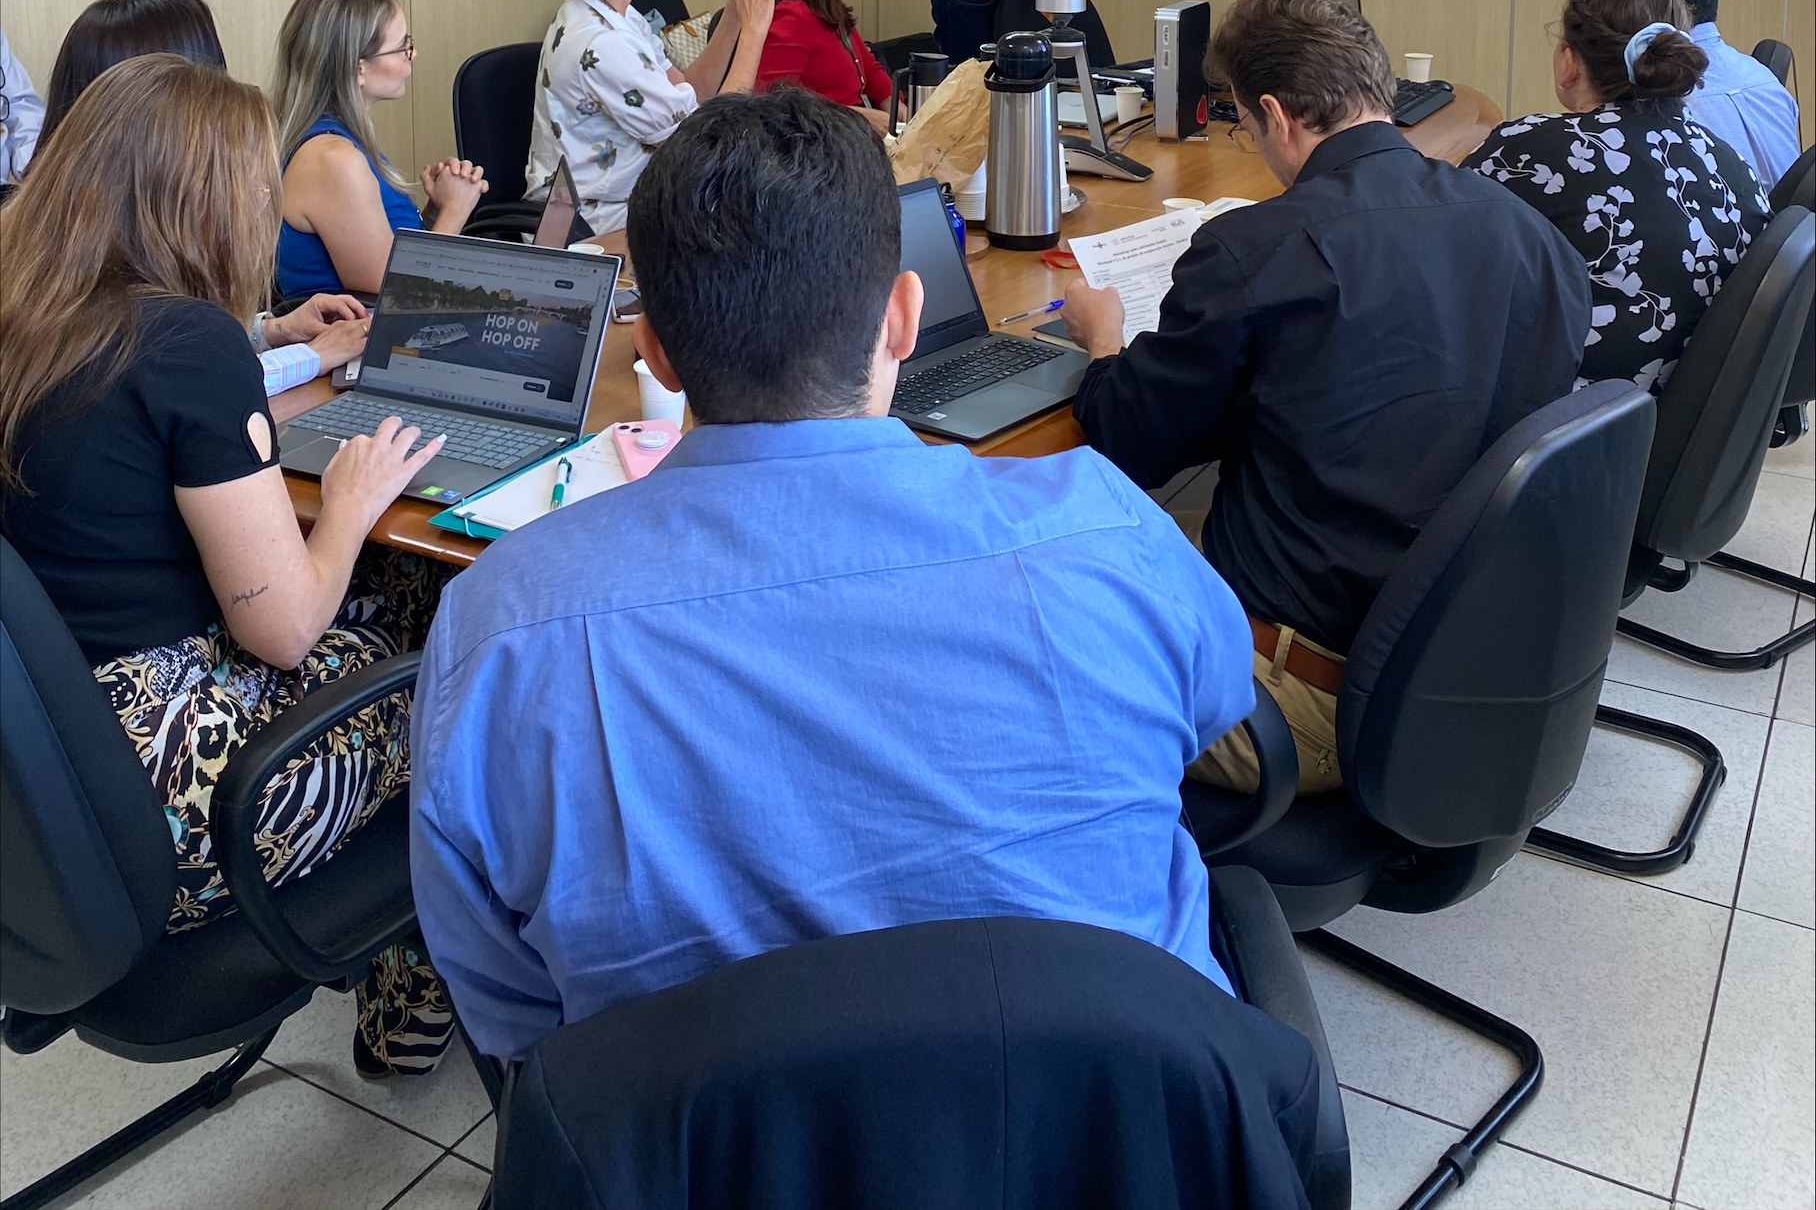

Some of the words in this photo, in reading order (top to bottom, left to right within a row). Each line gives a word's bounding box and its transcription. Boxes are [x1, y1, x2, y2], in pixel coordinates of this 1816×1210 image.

[485, 313, 516, 330] HOP
[517, 318, 539, 334] ON
[481, 330, 512, 346] HOP
[513, 335, 541, 351] OFF
